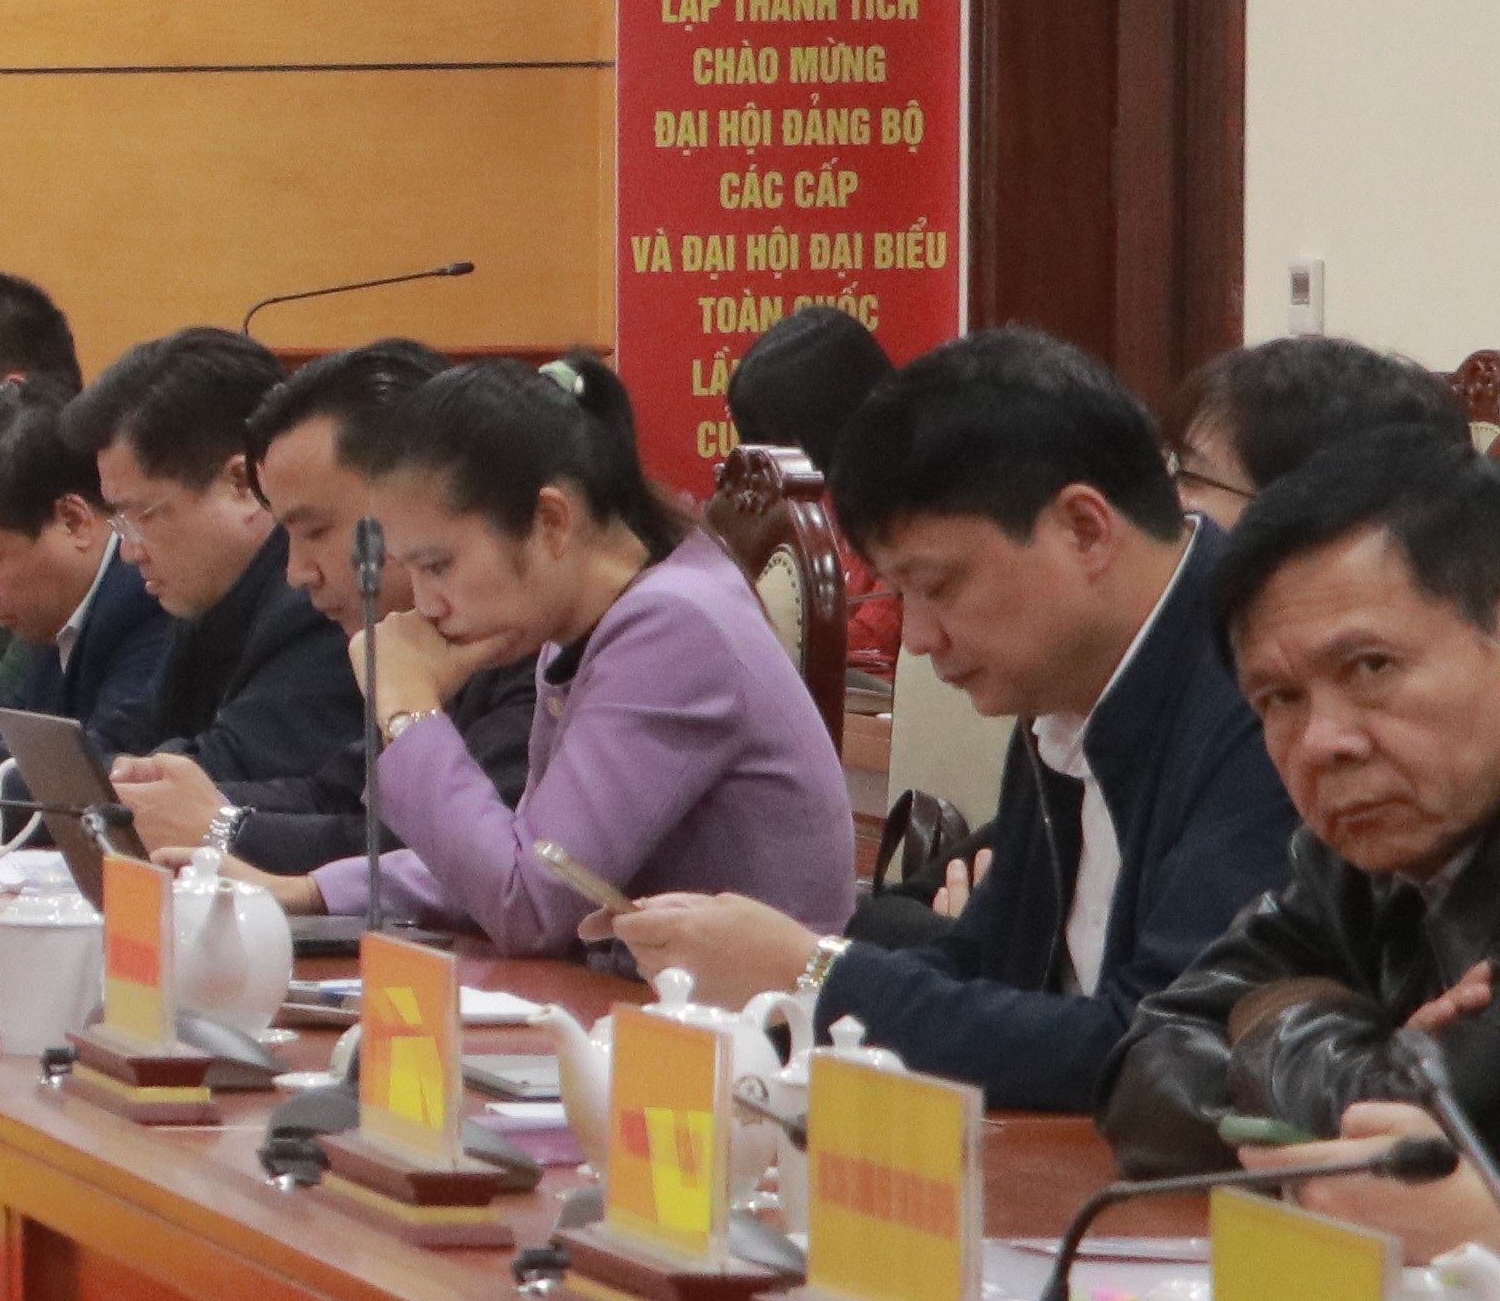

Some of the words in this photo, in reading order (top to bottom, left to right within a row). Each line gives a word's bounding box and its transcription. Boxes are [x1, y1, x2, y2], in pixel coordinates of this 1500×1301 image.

[694, 41, 780, 86] CHÀO
[791, 37, 887, 84] MỪNG
[655, 111, 709, 157] ĐẠI
[720, 103, 773, 156] HỘI
[783, 94, 871, 147] ĐẢNG
[883, 101, 924, 153] BỘ
[721, 165, 784, 210] CÁC
[796, 160, 859, 209] CẤP
[632, 229, 674, 274] VÀ
[681, 236, 737, 281] ĐẠI
[747, 227, 800, 280] HỘI
[810, 233, 864, 279] ĐẠI
[875, 218, 949, 270] BIỂU
[699, 288, 784, 334] TOÀN
[693, 347, 739, 397] LẦ
